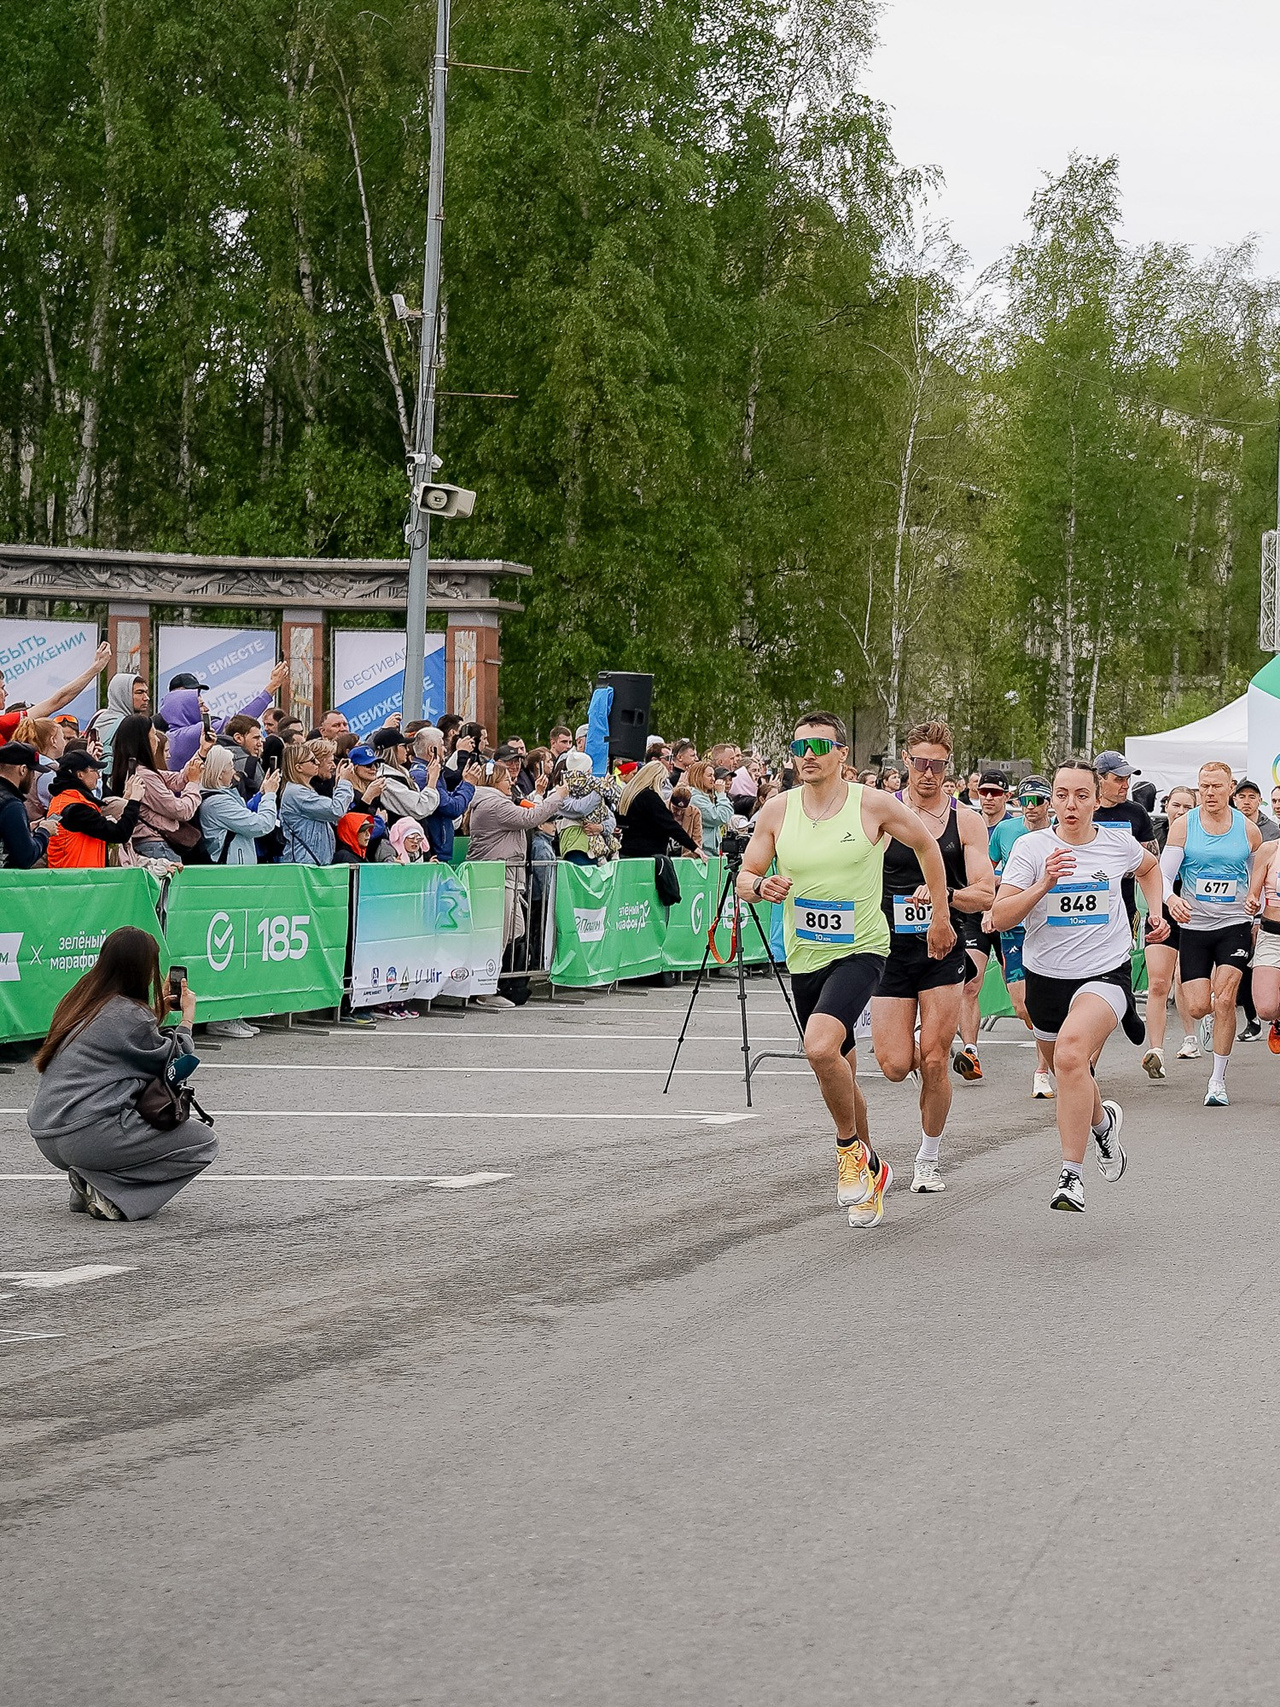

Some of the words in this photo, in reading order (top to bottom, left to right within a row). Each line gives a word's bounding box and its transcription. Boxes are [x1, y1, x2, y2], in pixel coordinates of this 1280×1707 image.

[0, 635, 47, 667] БЫТЬ
[4, 631, 87, 684] ДВИЖЕНИИ
[207, 639, 265, 675] ВМЕСТЕ
[207, 690, 238, 711] ЫТЬ
[1204, 882, 1229, 894] 677
[904, 906, 932, 921] 807
[1060, 894, 1097, 913] 848
[805, 911, 842, 930] 803
[58, 929, 108, 951] зелёный
[257, 915, 311, 962] 185
